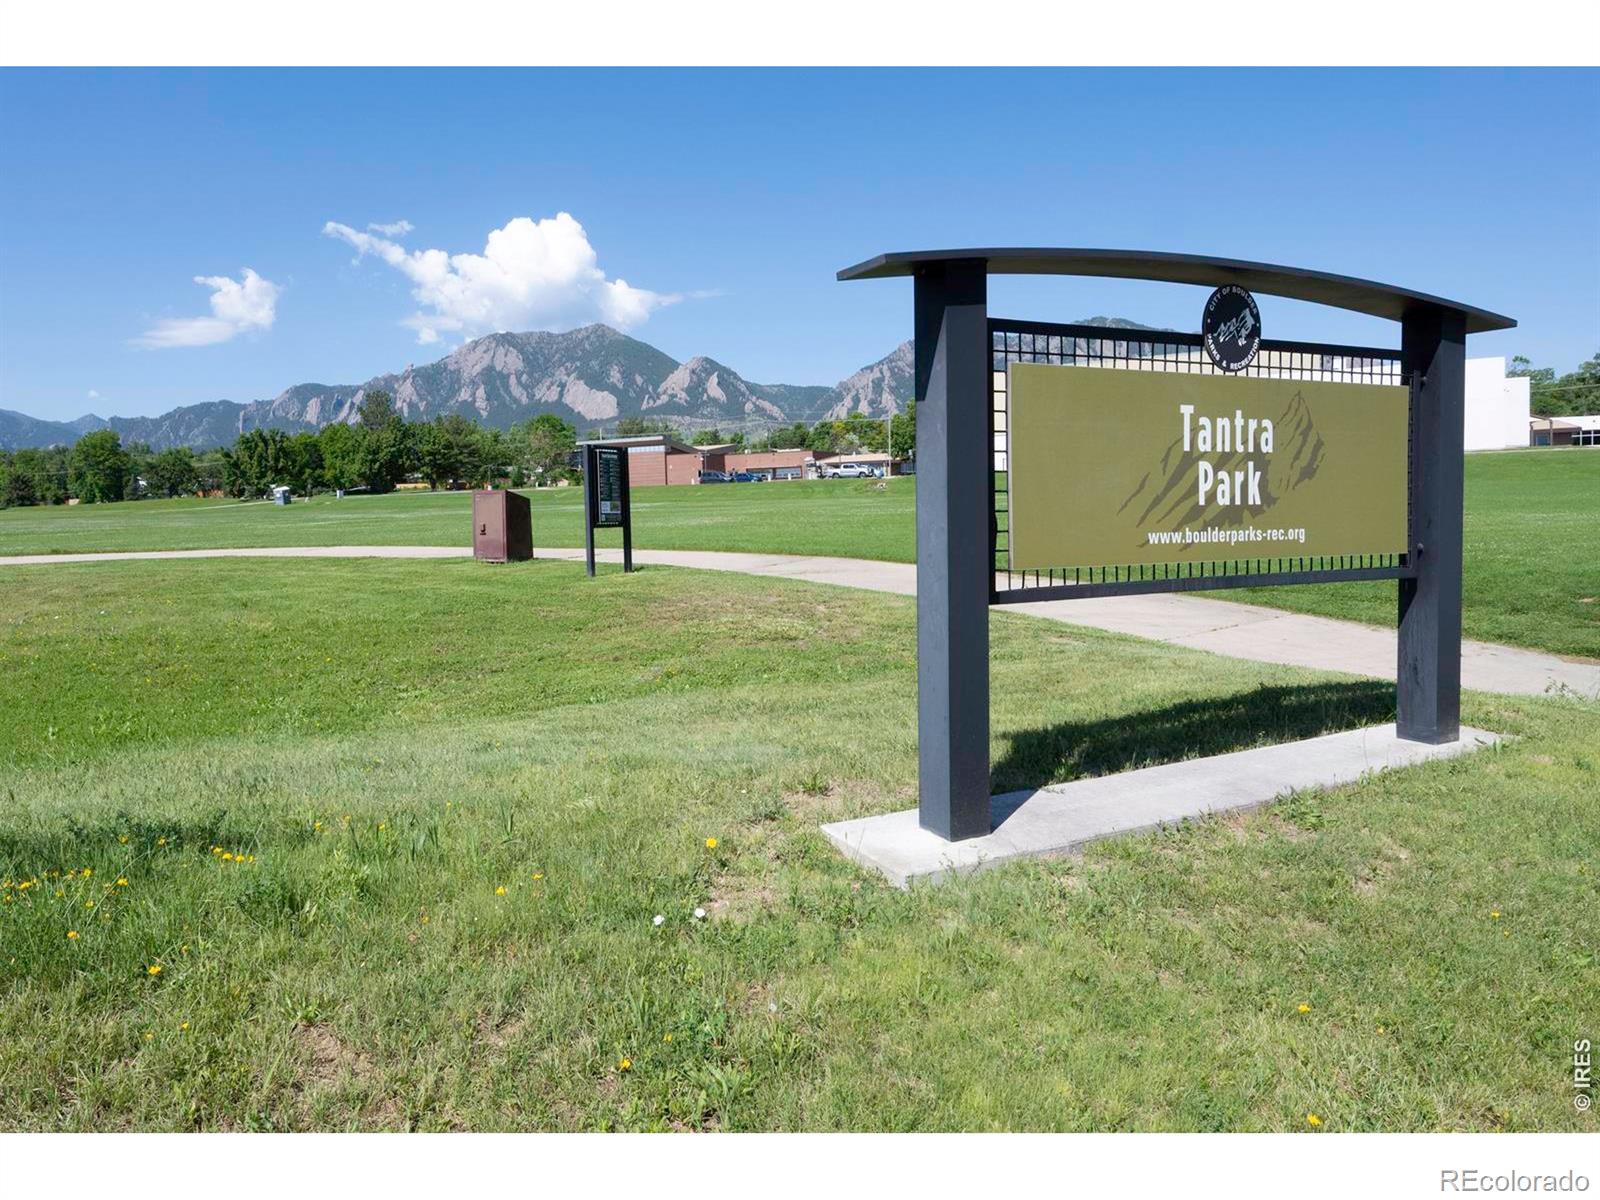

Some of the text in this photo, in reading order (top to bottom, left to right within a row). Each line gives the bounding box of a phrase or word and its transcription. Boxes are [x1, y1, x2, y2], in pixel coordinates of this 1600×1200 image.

[1209, 286, 1258, 314] CITY OF BOULDER
[1207, 333, 1221, 361] PARKS
[1230, 337, 1260, 370] RECREATION
[1180, 404, 1273, 453] Tantra
[1198, 461, 1261, 505] Park
[1148, 526, 1305, 545] www.boulderparks-rec.org
